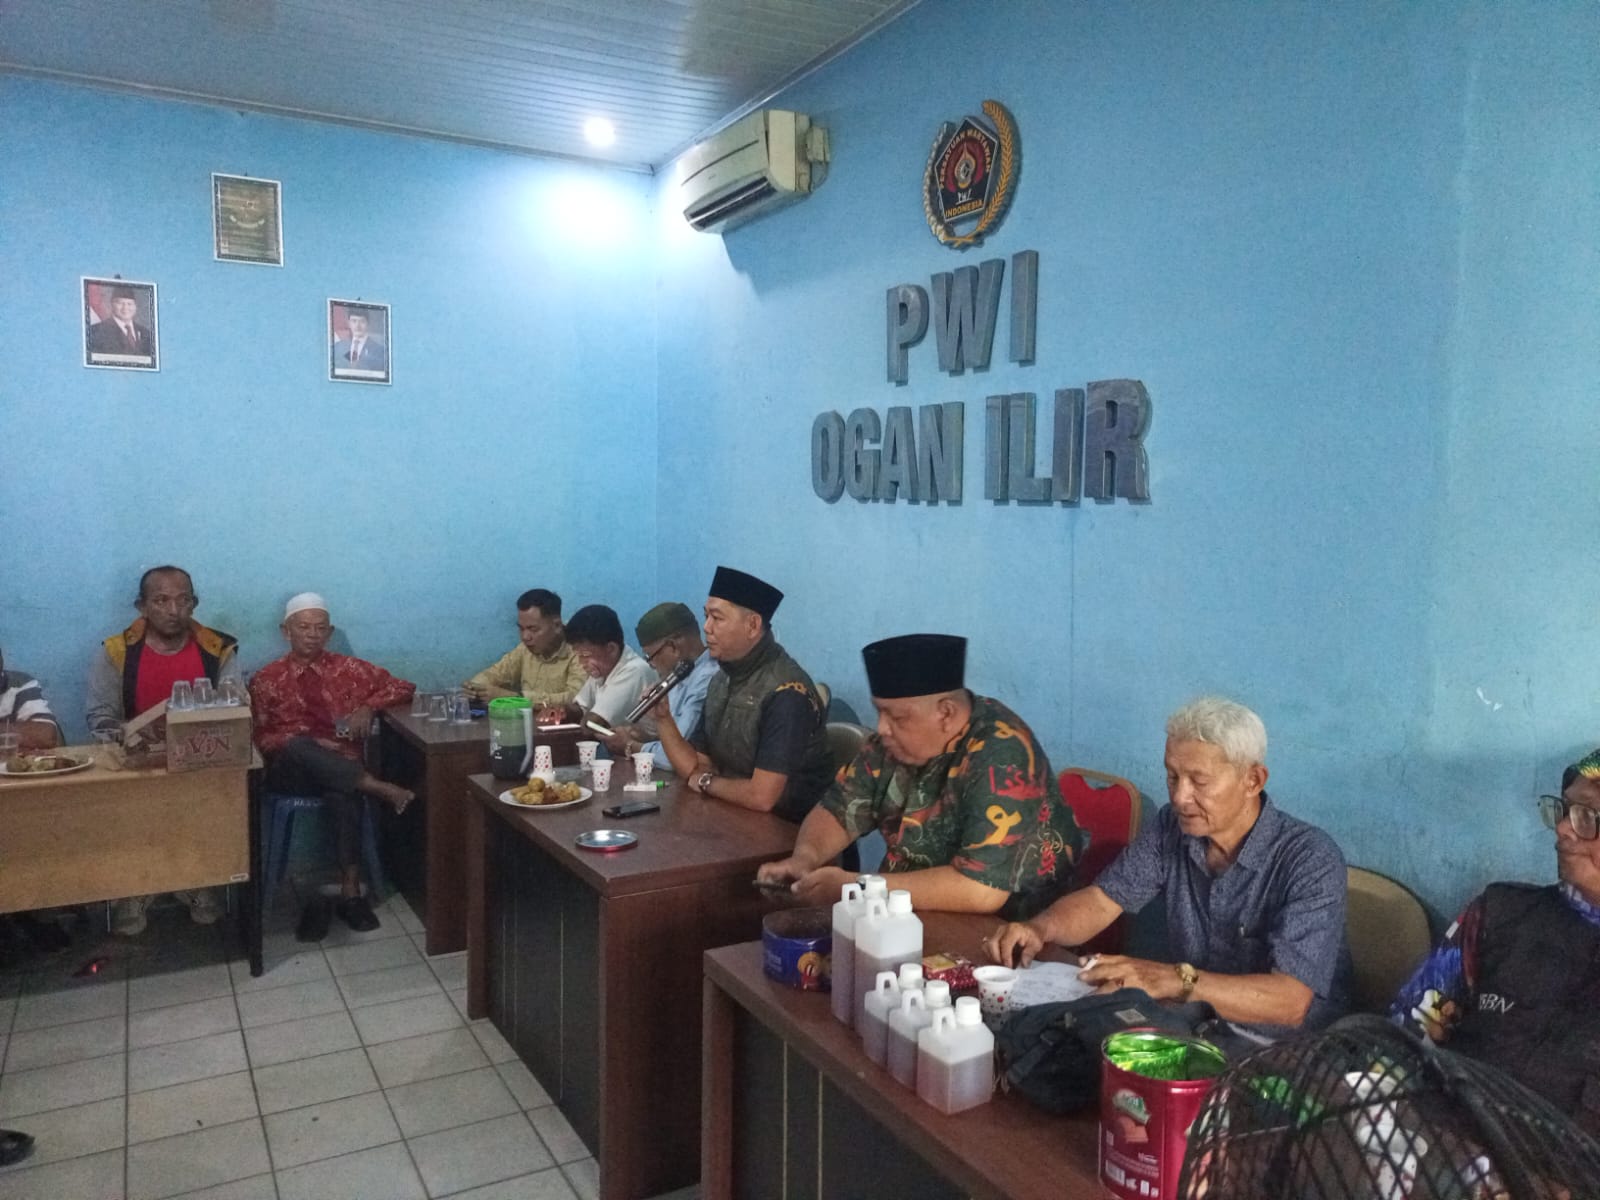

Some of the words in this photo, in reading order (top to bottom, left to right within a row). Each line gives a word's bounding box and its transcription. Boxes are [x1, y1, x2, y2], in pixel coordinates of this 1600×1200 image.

[944, 199, 983, 218] INDONESIA
[886, 250, 1039, 387] PWI
[811, 401, 965, 506] OGAN
[984, 378, 1153, 508] ILIR
